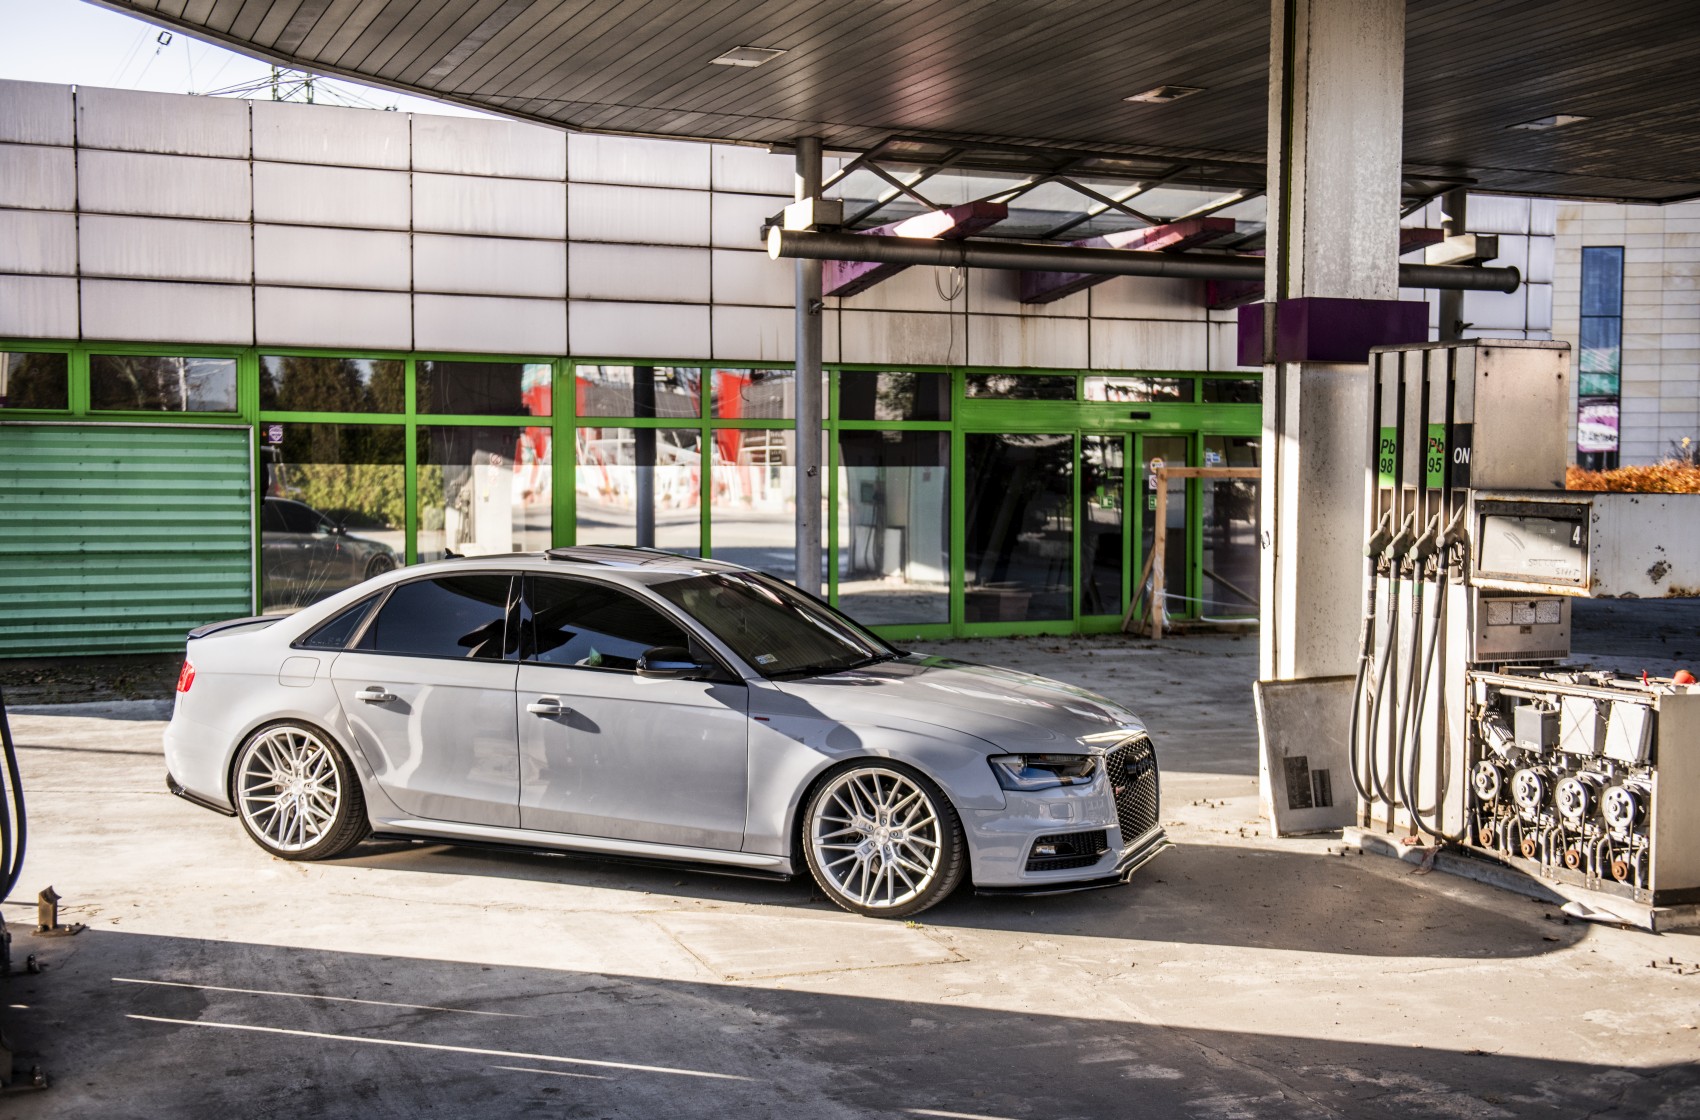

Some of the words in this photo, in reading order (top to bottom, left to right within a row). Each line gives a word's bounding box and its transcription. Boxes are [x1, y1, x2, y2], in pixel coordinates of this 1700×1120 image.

[1381, 439, 1396, 455] Pb
[1428, 438, 1444, 453] Pb
[1454, 447, 1470, 463] ON
[1380, 458, 1393, 473] 98
[1428, 457, 1442, 472] 95
[1572, 525, 1581, 545] 4
